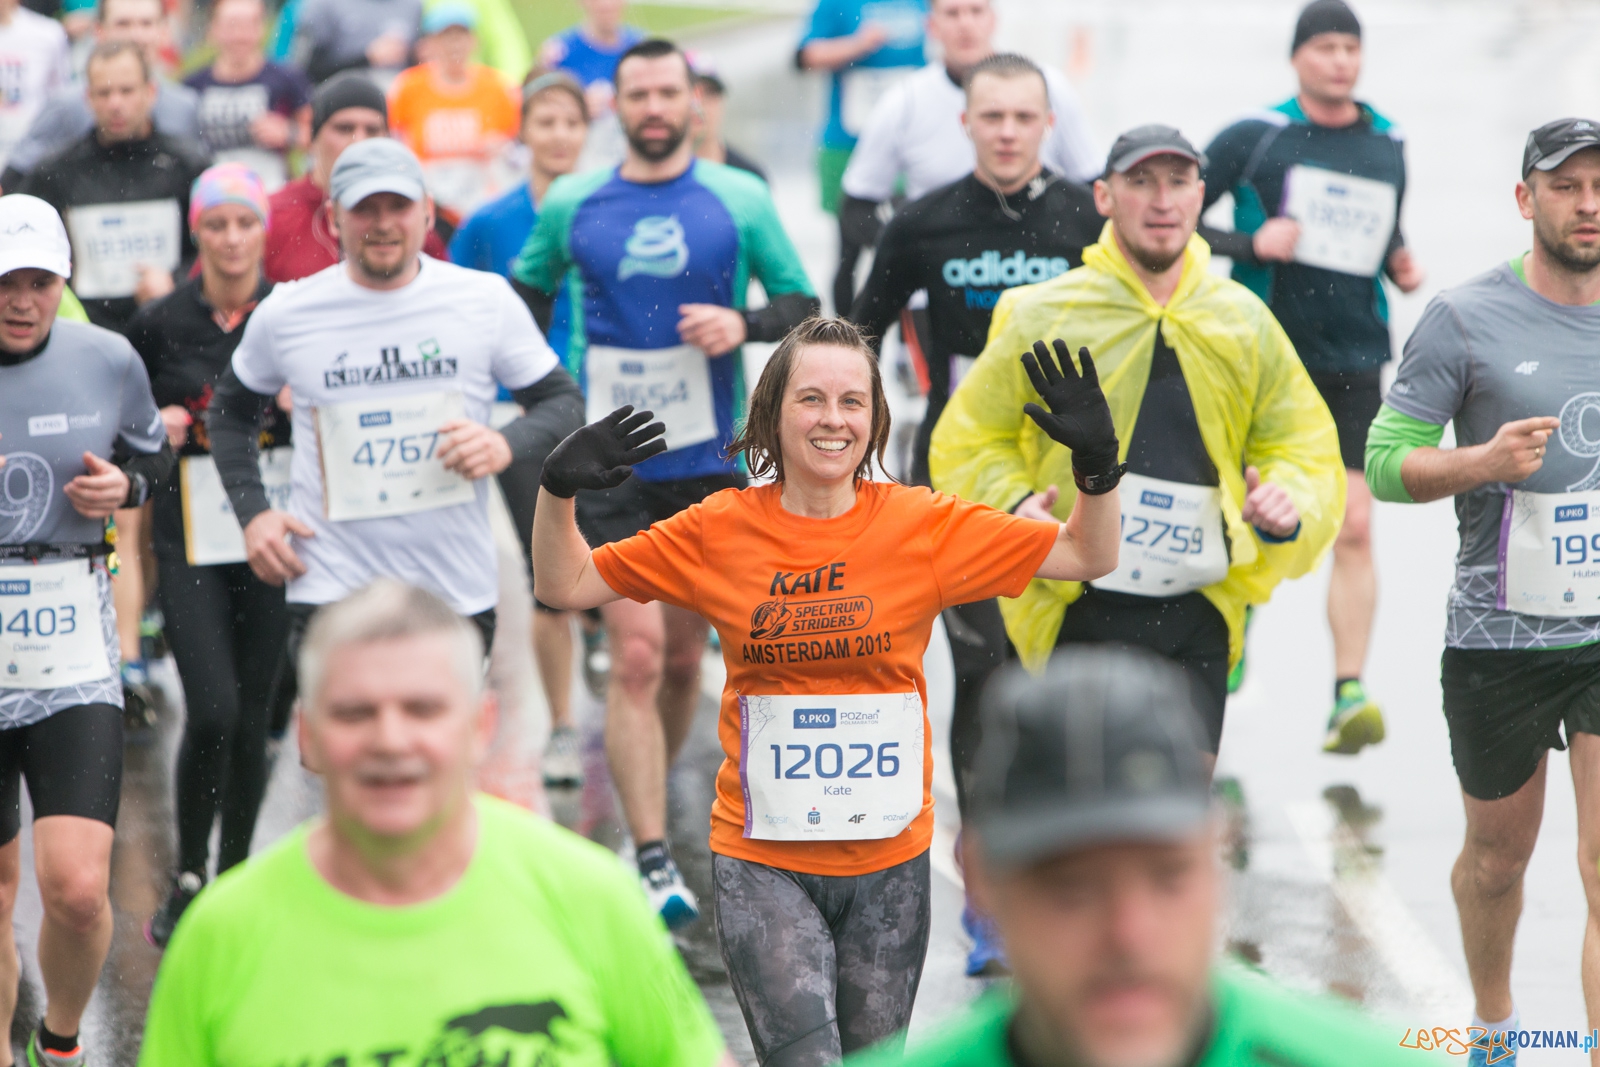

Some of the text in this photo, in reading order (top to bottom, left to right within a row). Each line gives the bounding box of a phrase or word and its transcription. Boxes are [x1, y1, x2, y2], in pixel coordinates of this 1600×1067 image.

[942, 249, 1070, 287] adidas
[352, 431, 439, 466] 4767
[769, 562, 846, 596] KATE
[0, 604, 76, 637] 403
[792, 614, 855, 631] STRIDERS
[794, 600, 865, 618] SPECTRUM
[743, 632, 891, 664] AMSTERDAM 2013
[770, 742, 900, 779] 12026
[823, 785, 852, 795] Kate
